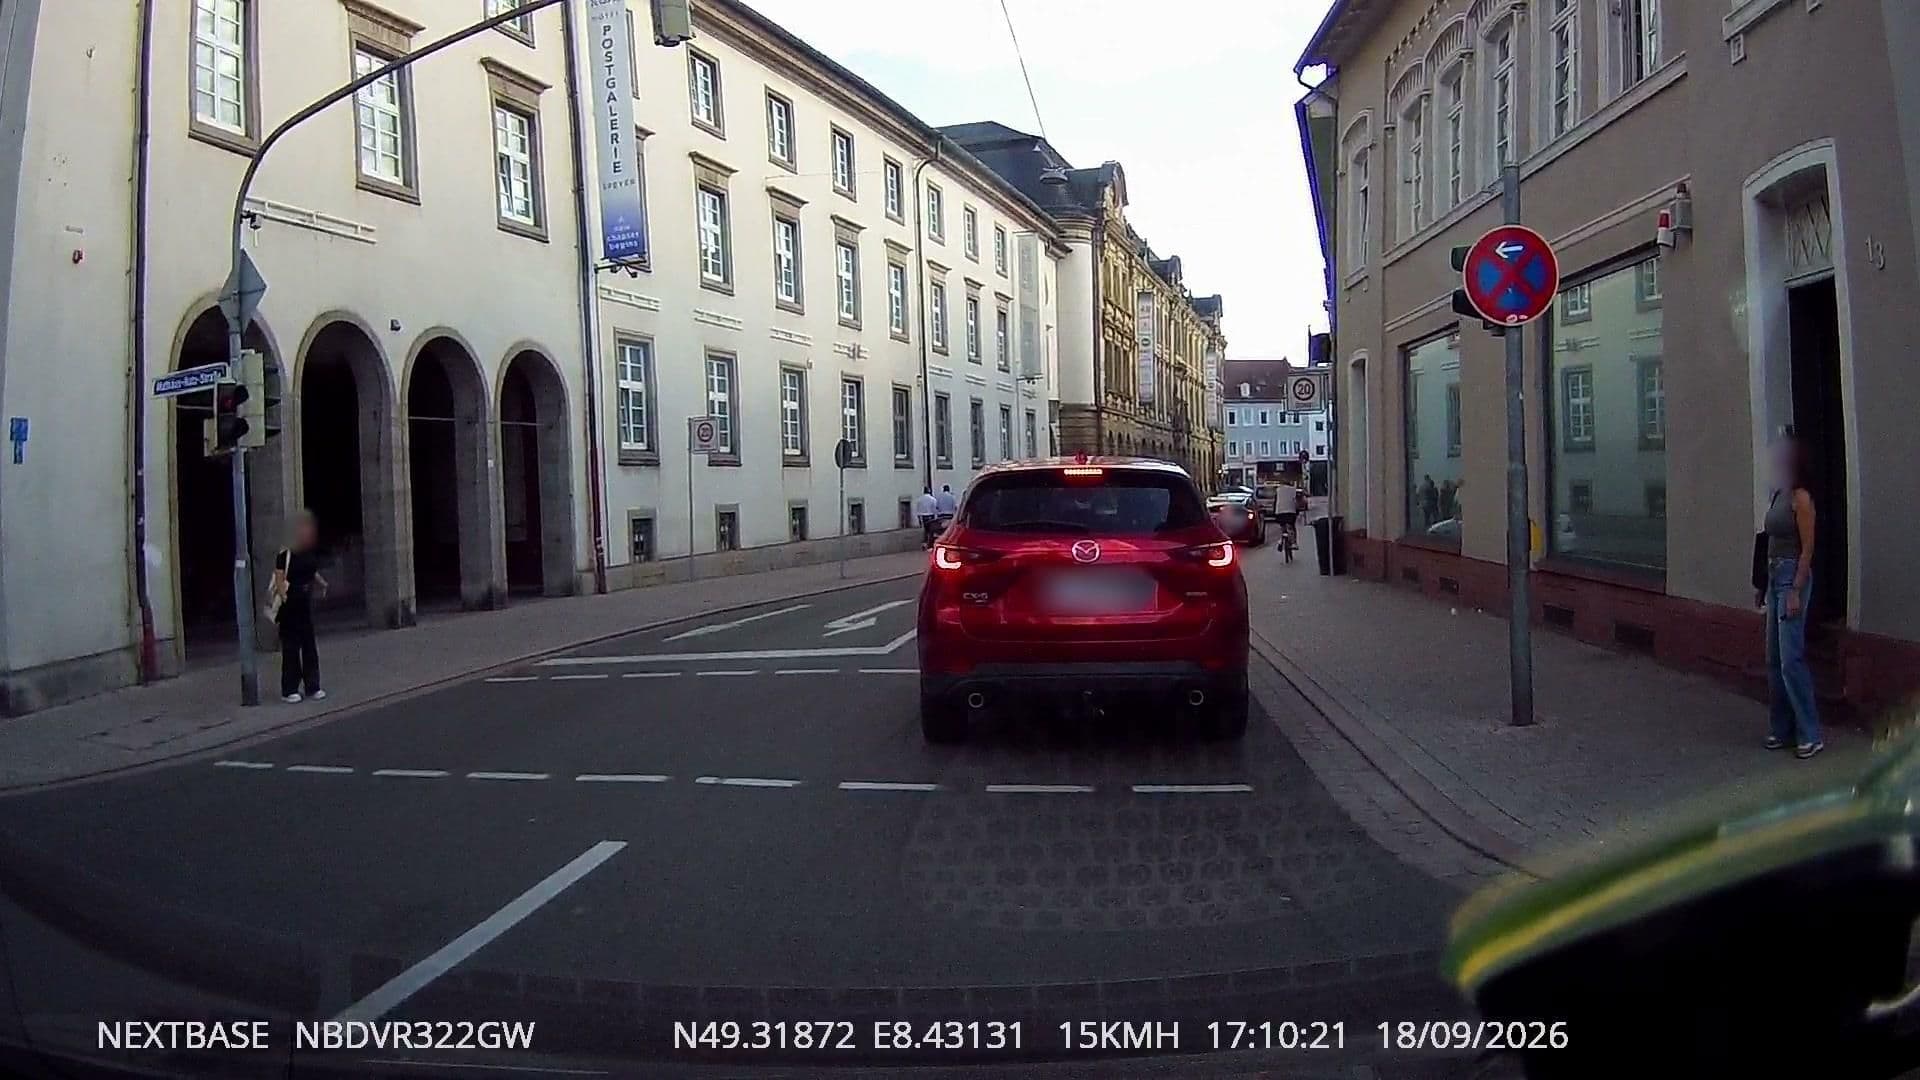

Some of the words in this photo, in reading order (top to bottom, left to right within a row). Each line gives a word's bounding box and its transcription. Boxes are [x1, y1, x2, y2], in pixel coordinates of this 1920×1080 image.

[601, 24, 622, 174] POSTGALERIE
[1297, 383, 1311, 396] 20
[963, 592, 988, 600] CX-5
